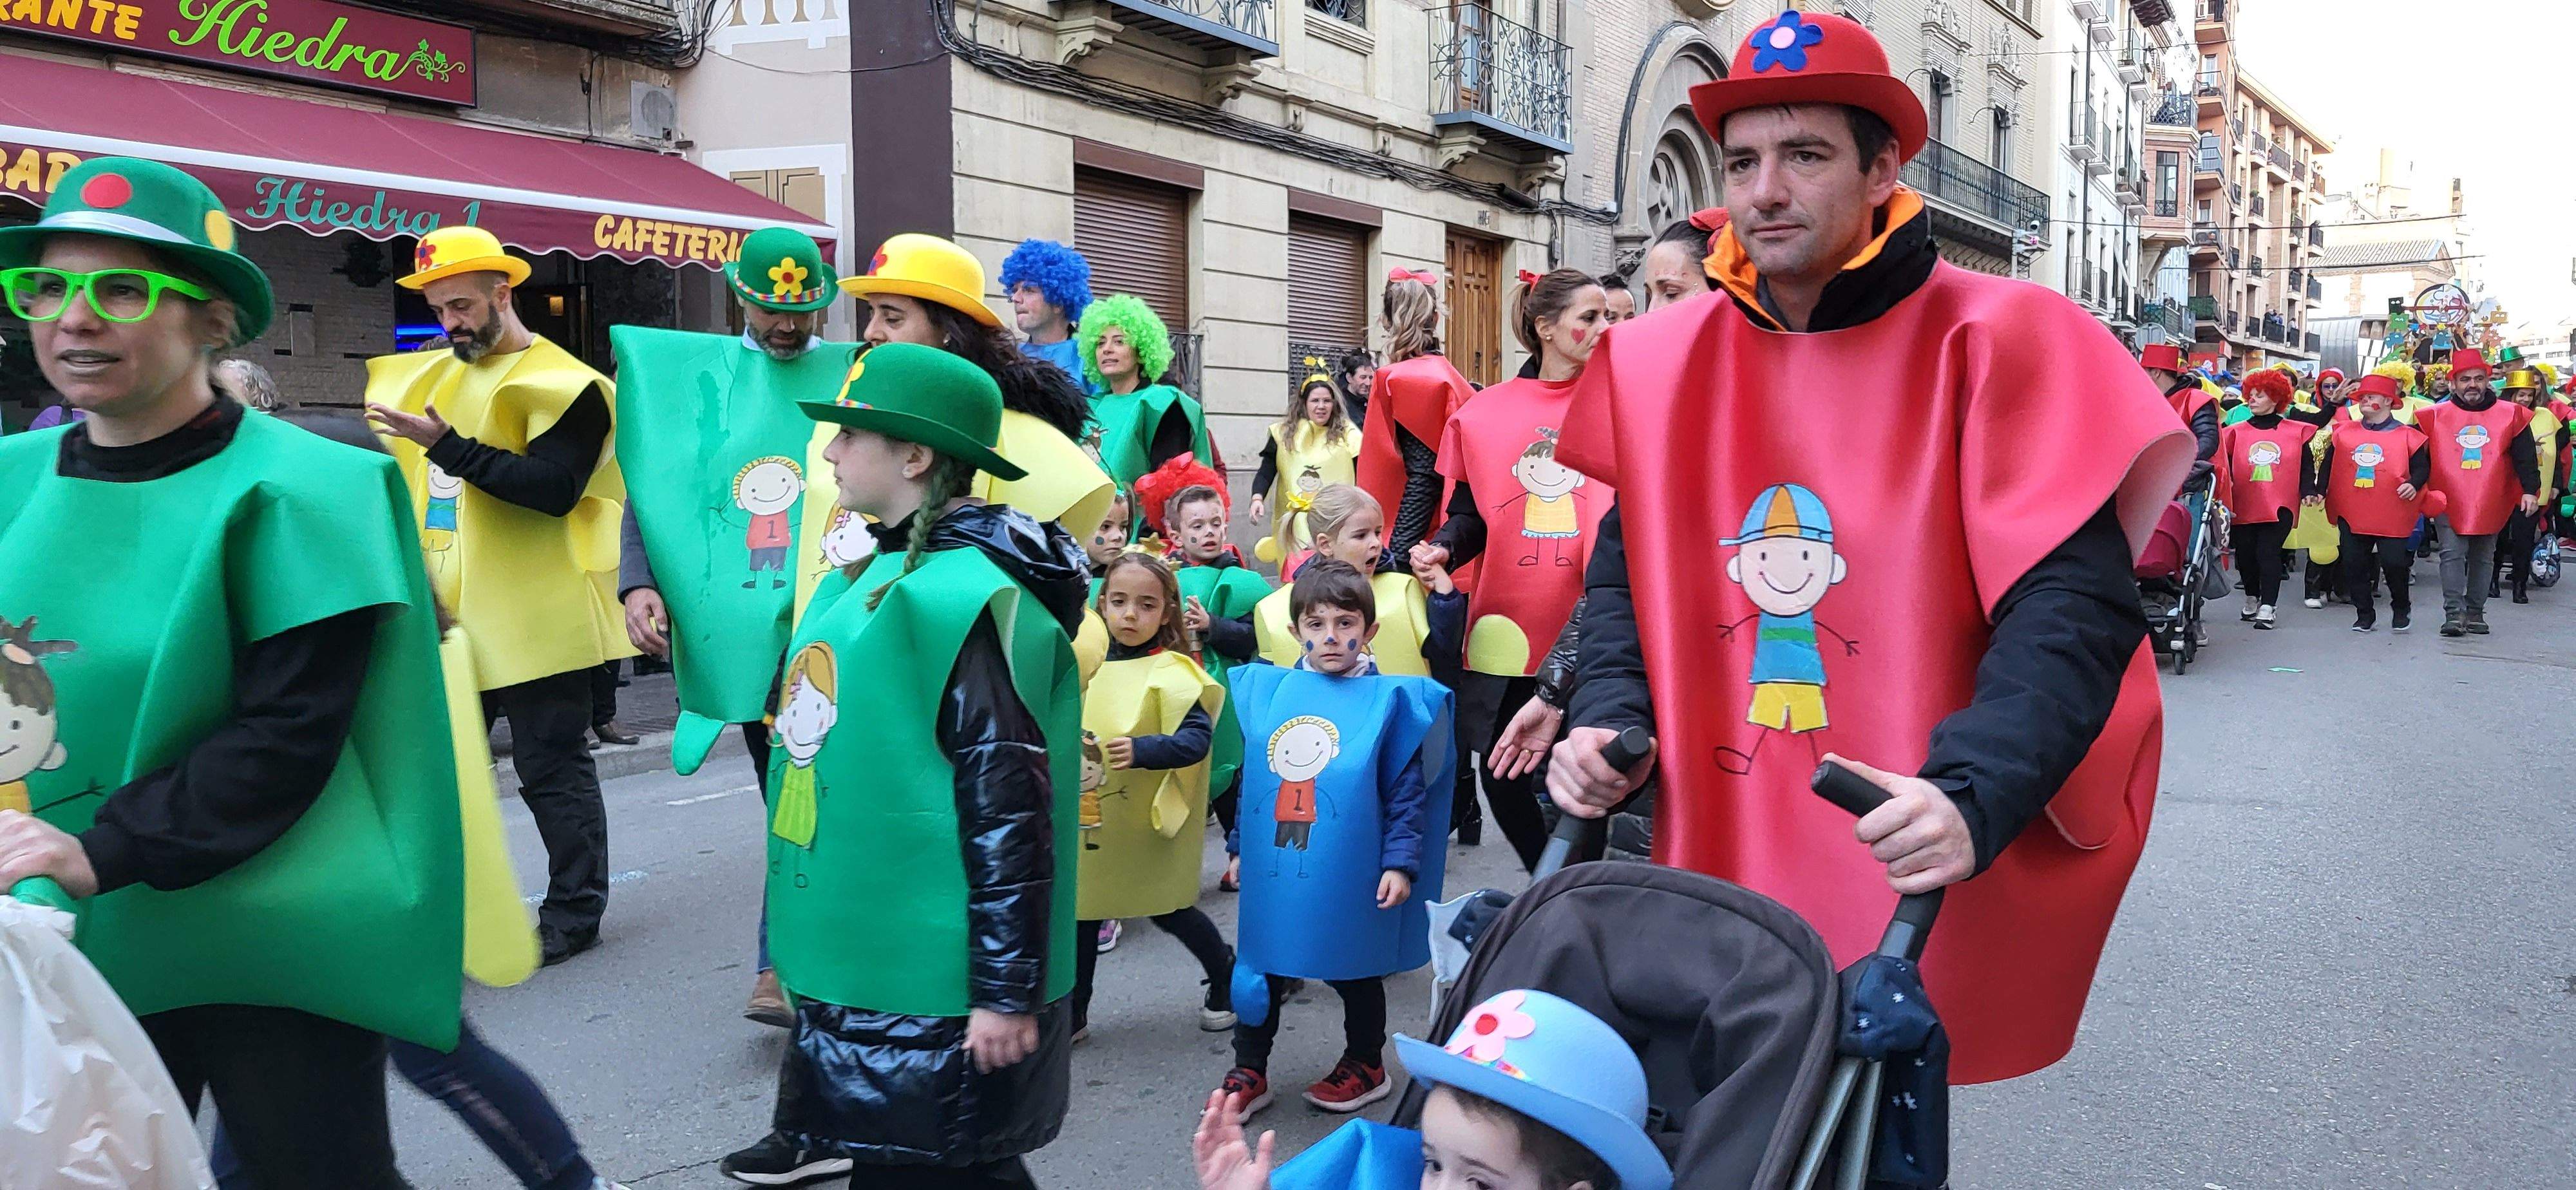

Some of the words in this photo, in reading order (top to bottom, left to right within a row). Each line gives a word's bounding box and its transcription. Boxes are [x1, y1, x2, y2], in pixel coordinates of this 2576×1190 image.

[168, 0, 410, 81] Hiedra
[245, 176, 441, 235] Hiedra
[462, 200, 480, 227] 1
[594, 214, 750, 263] CAFETERI
[767, 520, 777, 538] 1
[1293, 788, 1303, 811] 1
